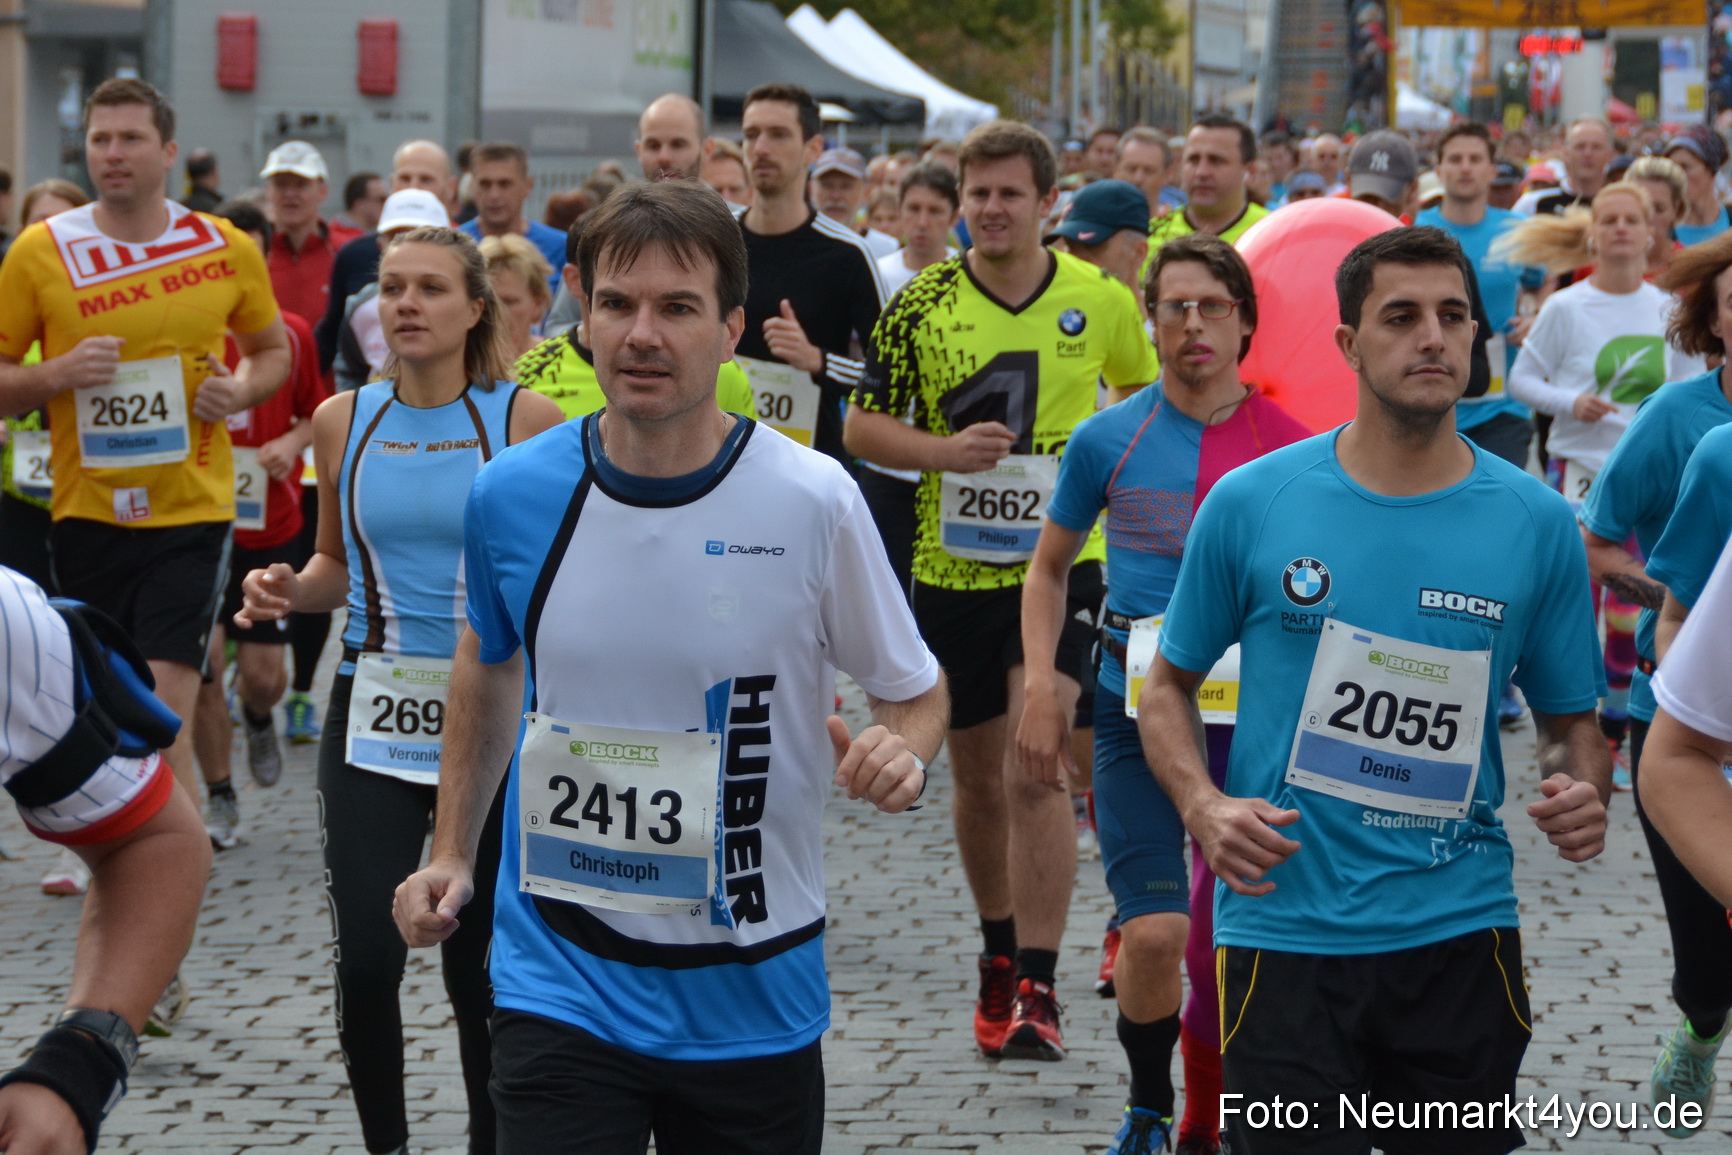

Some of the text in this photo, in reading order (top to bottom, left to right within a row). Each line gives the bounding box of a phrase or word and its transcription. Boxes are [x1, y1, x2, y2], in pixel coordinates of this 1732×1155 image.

[77, 259, 236, 319] MAX BÖGL
[90, 391, 169, 427] 2624
[106, 436, 158, 450] Christian
[958, 487, 1040, 521] 2662
[978, 531, 1018, 546] Philipp
[1418, 609, 1447, 620] inspired
[1449, 613, 1459, 622] by
[1420, 588, 1507, 623] BOCK
[1386, 654, 1450, 680] BOCK
[370, 694, 445, 736] 269
[1327, 681, 1462, 751] 2055
[589, 741, 660, 762] BOCK
[1359, 755, 1412, 783] Denis
[548, 775, 683, 844] 2413
[724, 674, 777, 931] HUBER
[531, 815, 538, 825] D
[570, 850, 660, 883] Christoph
